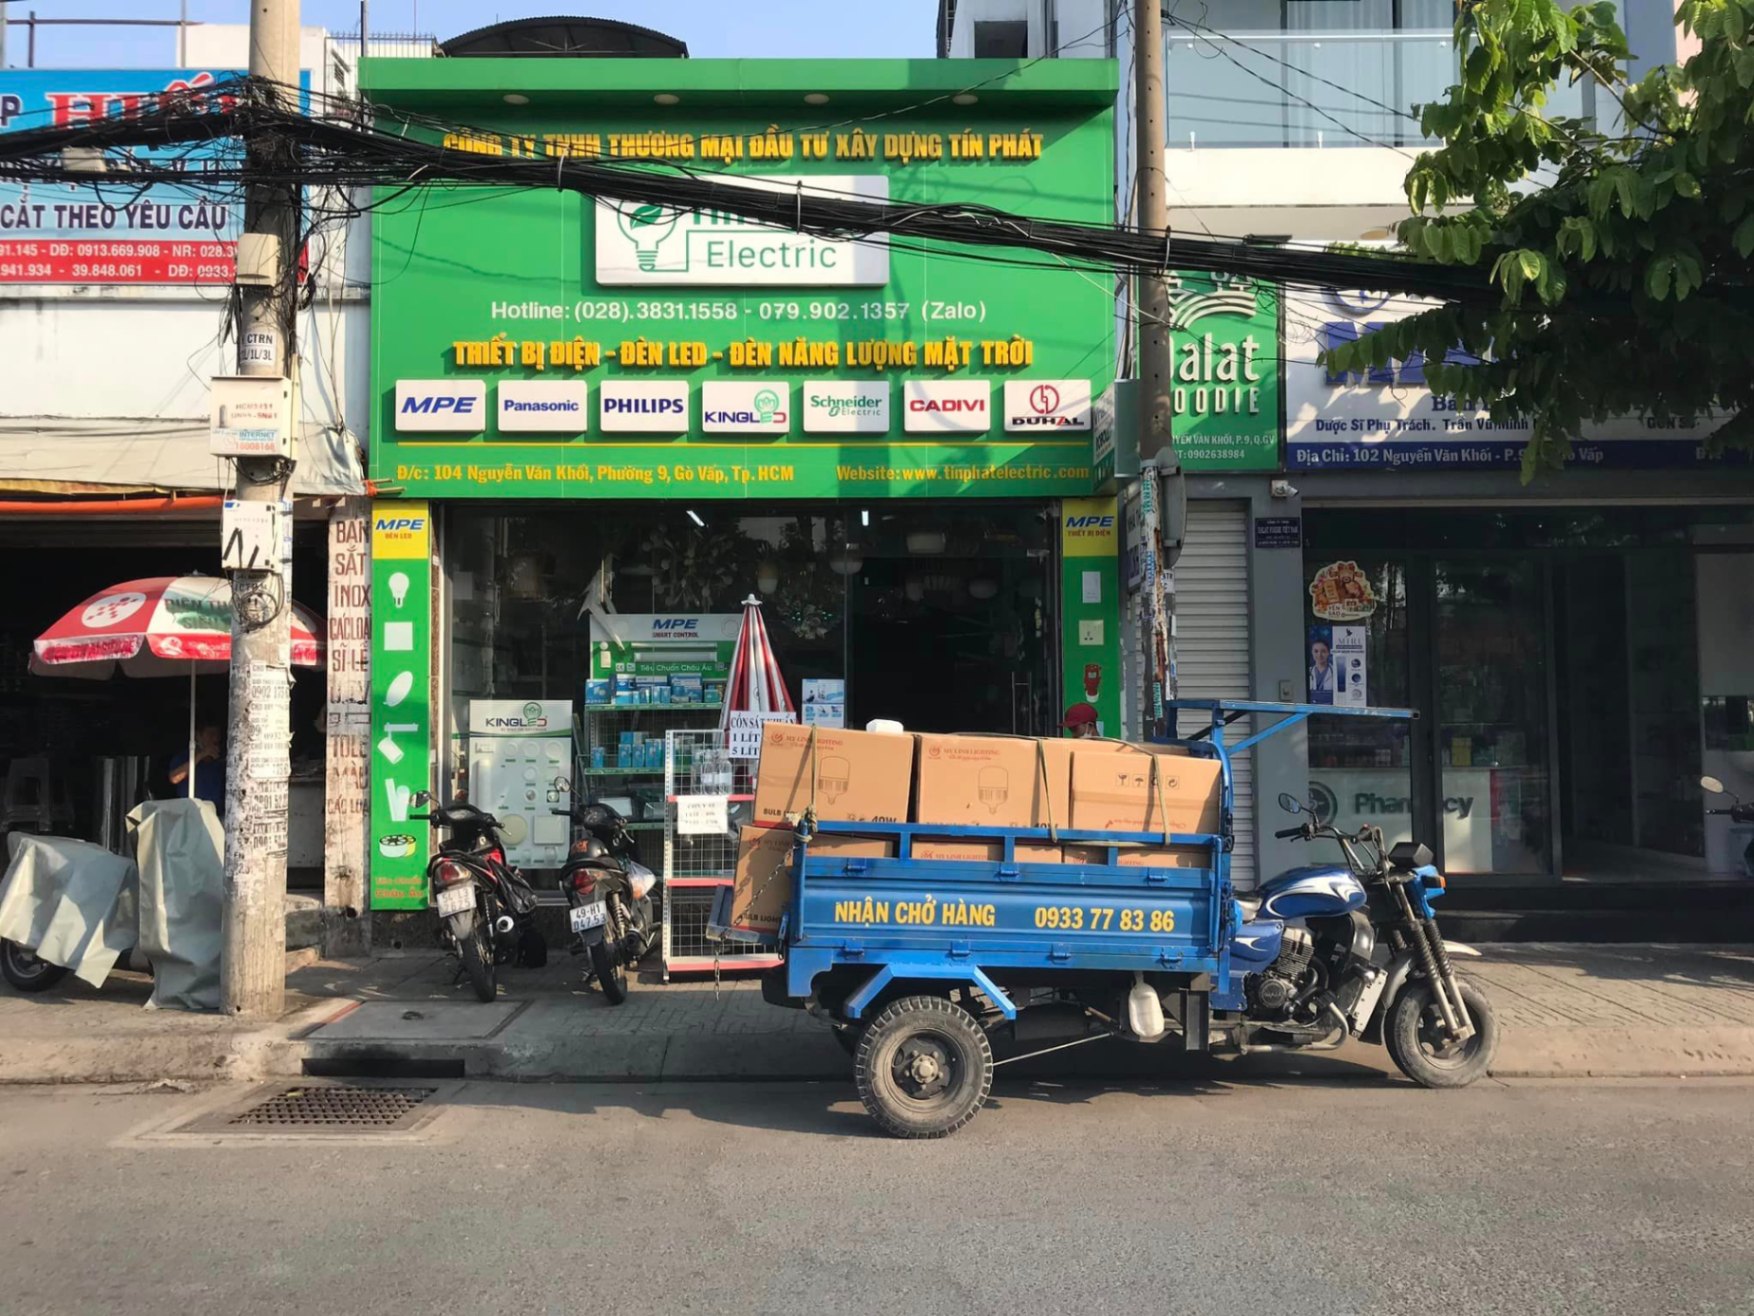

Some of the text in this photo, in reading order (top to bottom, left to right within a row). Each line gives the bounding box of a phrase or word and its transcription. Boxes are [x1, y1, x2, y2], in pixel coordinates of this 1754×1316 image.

[511, 134, 536, 158] TY
[543, 134, 601, 158] TNHH
[608, 130, 695, 158] THƯƠNG
[701, 134, 743, 164] MẠI
[749, 124, 793, 158] ĐẦU
[800, 130, 830, 158] TƯ
[836, 128, 877, 158] XÂY
[884, 131, 942, 165] DỰNG
[949, 128, 983, 158] TÍN
[989, 128, 1044, 159] PHÁT
[54, 204, 116, 229] THEO
[125, 199, 170, 229] YÊU
[178, 196, 226, 229] CẦU
[77, 245, 160, 257] 0913.669.908
[172, 245, 197, 257] NR:
[707, 239, 837, 269] Electric
[72, 264, 142, 276] 39.848.061
[491, 301, 570, 320] Hotline:
[759, 301, 910, 321] 079.902.1357
[921, 301, 987, 323] (Zalo)
[454, 332, 1033, 371] THIẾT BỊ ĐIỆN ĐÈN LED ĐÈN NĂNG LƯỢNG MẶT TRỜI
[1170, 332, 1260, 382] alat
[401, 396, 477, 414] MPE
[504, 399, 579, 413] Panasonic
[604, 398, 683, 414] PHILIPS
[811, 395, 882, 409] Schneider
[910, 399, 985, 412] CADIVI
[1174, 387, 1259, 413] OODIE
[840, 408, 881, 416] Electric
[1012, 416, 1084, 426] DUHAL
[1316, 419, 1349, 434] Dược
[1367, 418, 1391, 434] Phụ
[1396, 417, 1436, 431] Trách.
[1297, 447, 1320, 466] Địa
[1322, 446, 1350, 463] Chỉ:
[1354, 449, 1379, 463] 102
[1383, 446, 1432, 466] Nguyễn
[1434, 449, 1458, 463] Văn
[1462, 447, 1492, 463] Khối
[1579, 446, 1604, 464] Vấp
[397, 463, 794, 484] Đ/c: 104 Nguyễn Văn Khối, Phường 9, Gò Vấp, Tp. HCM
[376, 519, 424, 530] MPE
[1066, 516, 1114, 527] MPE
[335, 545, 367, 576] SẮT
[653, 619, 698, 629] MPE
[834, 893, 996, 927] NHẬN CHỞ HÀNG
[1034, 906, 1175, 932] 0933 77 83 86
